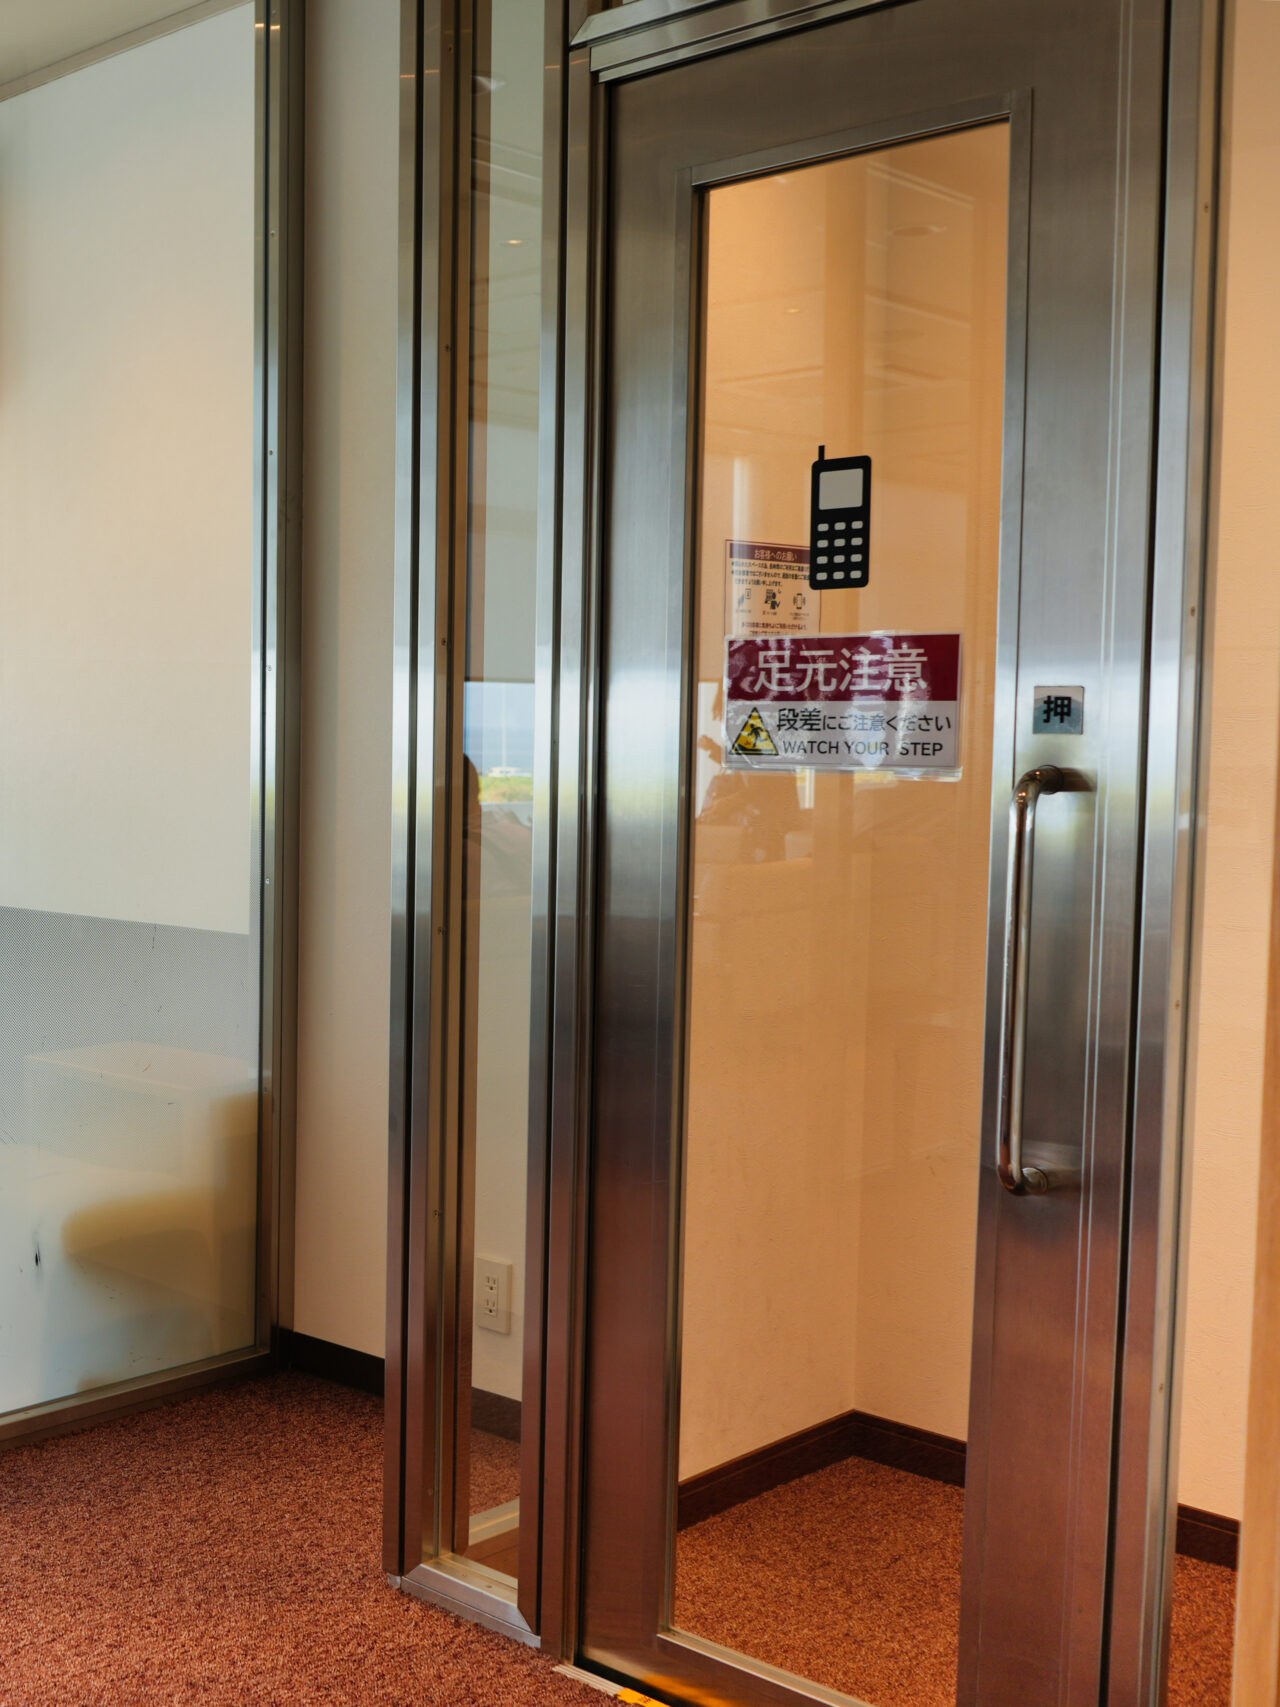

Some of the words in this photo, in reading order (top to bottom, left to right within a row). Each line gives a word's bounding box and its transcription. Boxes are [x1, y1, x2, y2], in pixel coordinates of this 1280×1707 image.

[753, 647, 928, 692] 足元注意
[776, 707, 952, 732] 段差にご注意ください
[1043, 696, 1071, 723] 押
[782, 740, 840, 755] WATCH
[844, 740, 890, 756] YOUR
[898, 741, 944, 757] STEP
